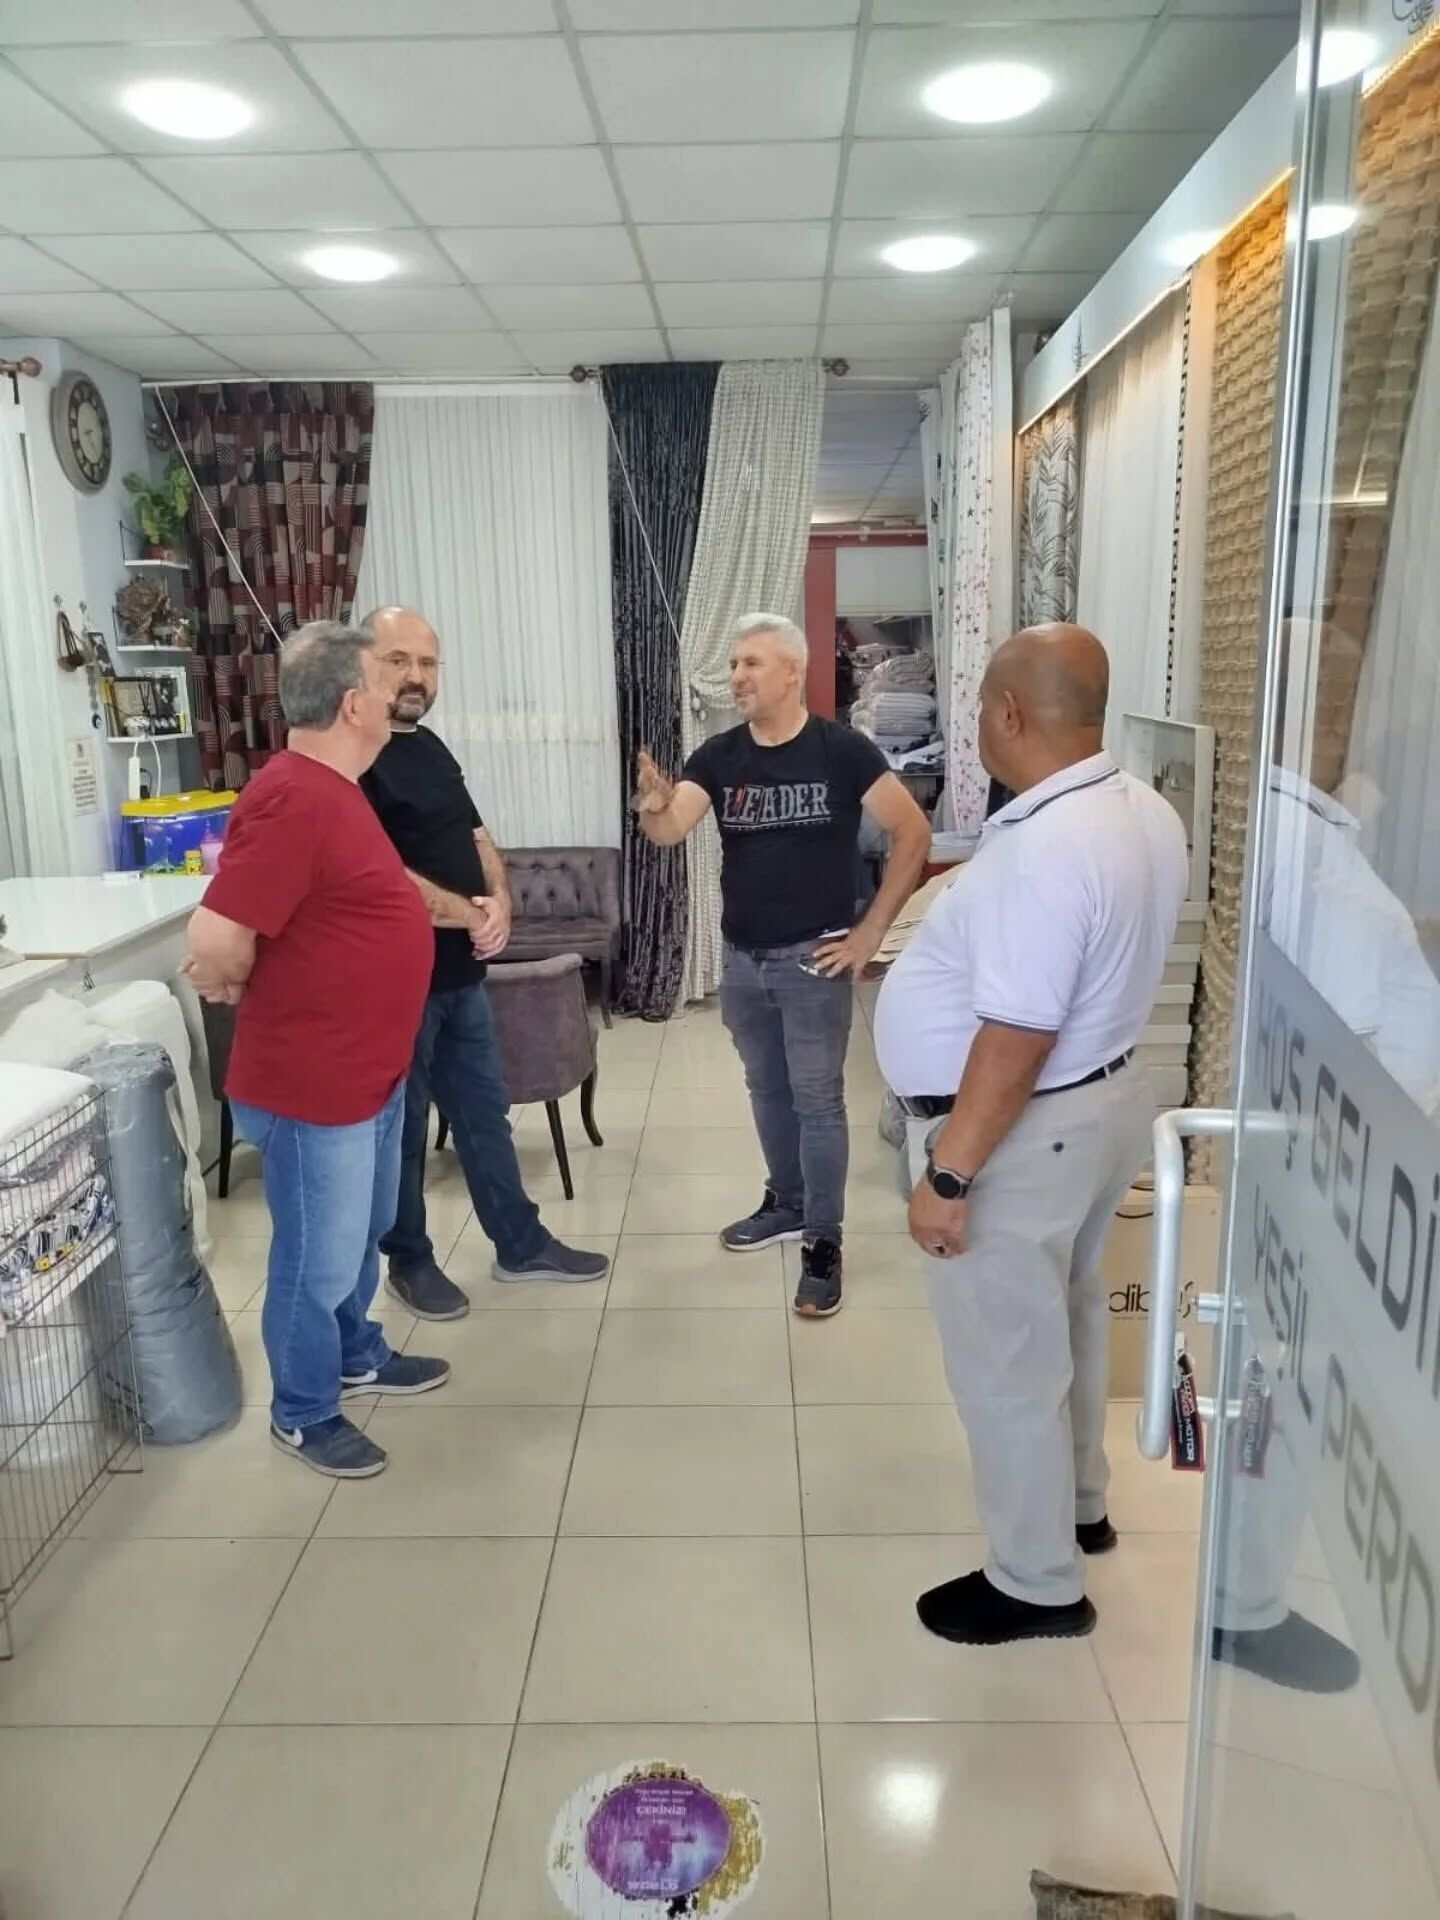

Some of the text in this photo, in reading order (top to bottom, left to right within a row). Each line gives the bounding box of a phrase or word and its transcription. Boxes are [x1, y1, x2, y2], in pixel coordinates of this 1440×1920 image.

[721, 783, 831, 823] LEADER
[1254, 984, 1440, 1399] HOŞ GELDİ
[1253, 1183, 1440, 1786] YEŞİL PERD
